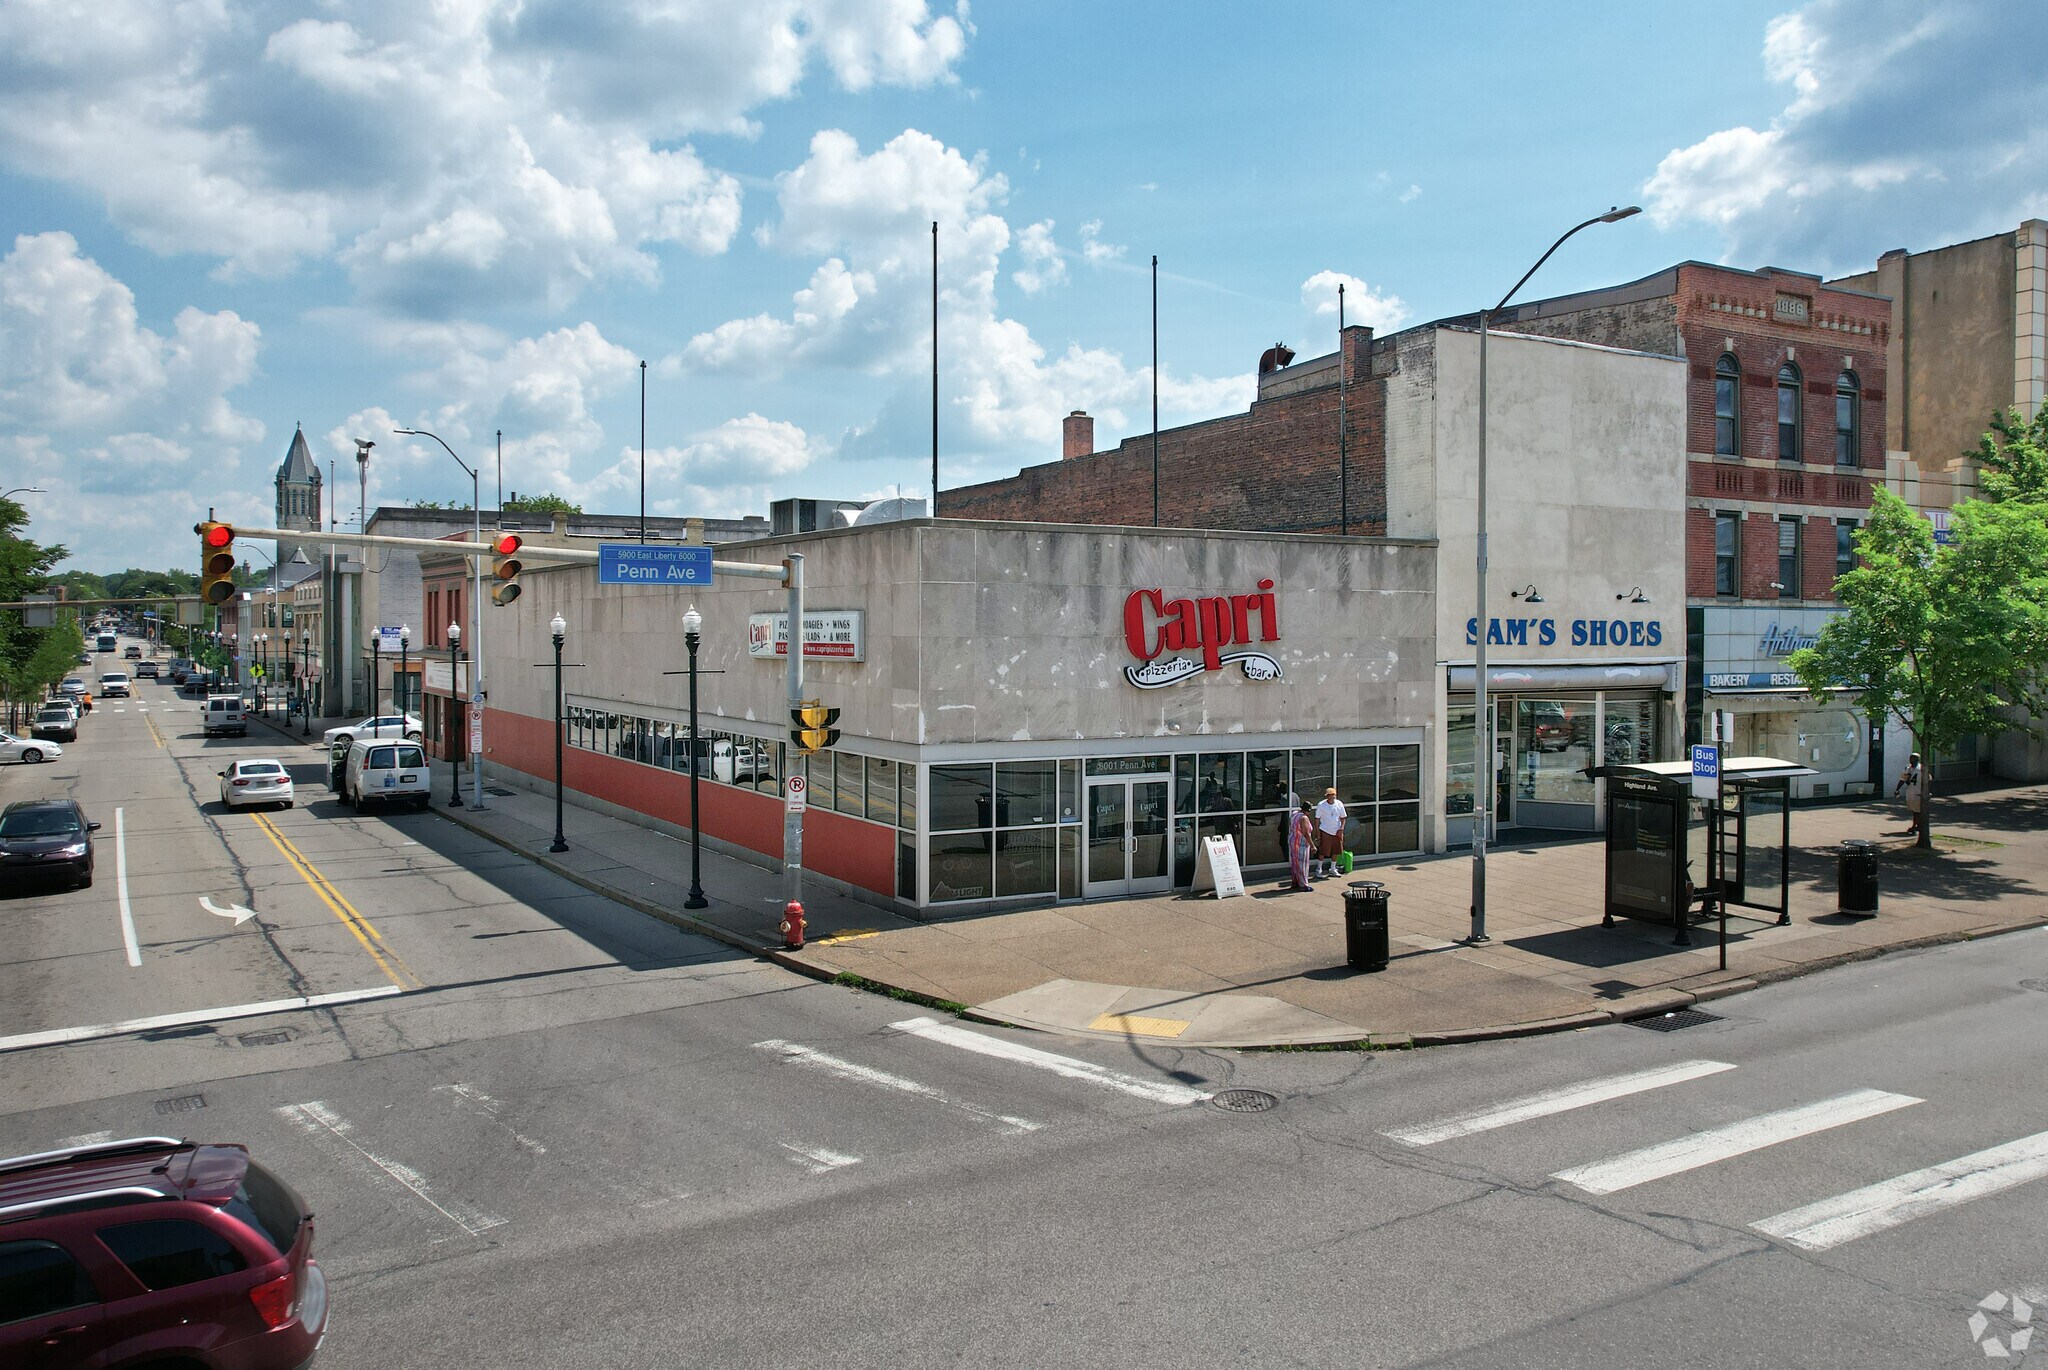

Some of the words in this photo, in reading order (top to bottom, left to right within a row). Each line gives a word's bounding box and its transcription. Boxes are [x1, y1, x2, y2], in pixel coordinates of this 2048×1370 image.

[618, 551, 635, 559] 5900
[637, 552, 652, 560] East
[654, 552, 677, 561] Liberty
[678, 552, 696, 560] 6000
[617, 563, 659, 578] Penn
[666, 564, 696, 579] Ave
[779, 620, 788, 629] PIZ
[832, 619, 850, 629] WINGS
[1124, 578, 1281, 671] Capri
[750, 620, 772, 648] Capri
[778, 632, 788, 640] PAS
[835, 632, 851, 642] MORE
[1466, 618, 1557, 647] SAM'S
[1572, 619, 1663, 647] SHOES
[1146, 659, 1188, 682] pizzeria
[1250, 658, 1268, 678] bar
[1709, 674, 1750, 687] BAKERY
[1770, 673, 1802, 686] RESTA
[1695, 749, 1714, 760] Bus
[1120, 760, 1139, 770] Penn
[1140, 759, 1156, 769] Ave
[1694, 761, 1716, 775] Stop
[1624, 782, 1646, 790] Highland
[1646, 784, 1659, 792] Ave.
[959, 887, 983, 897] LIGHT
